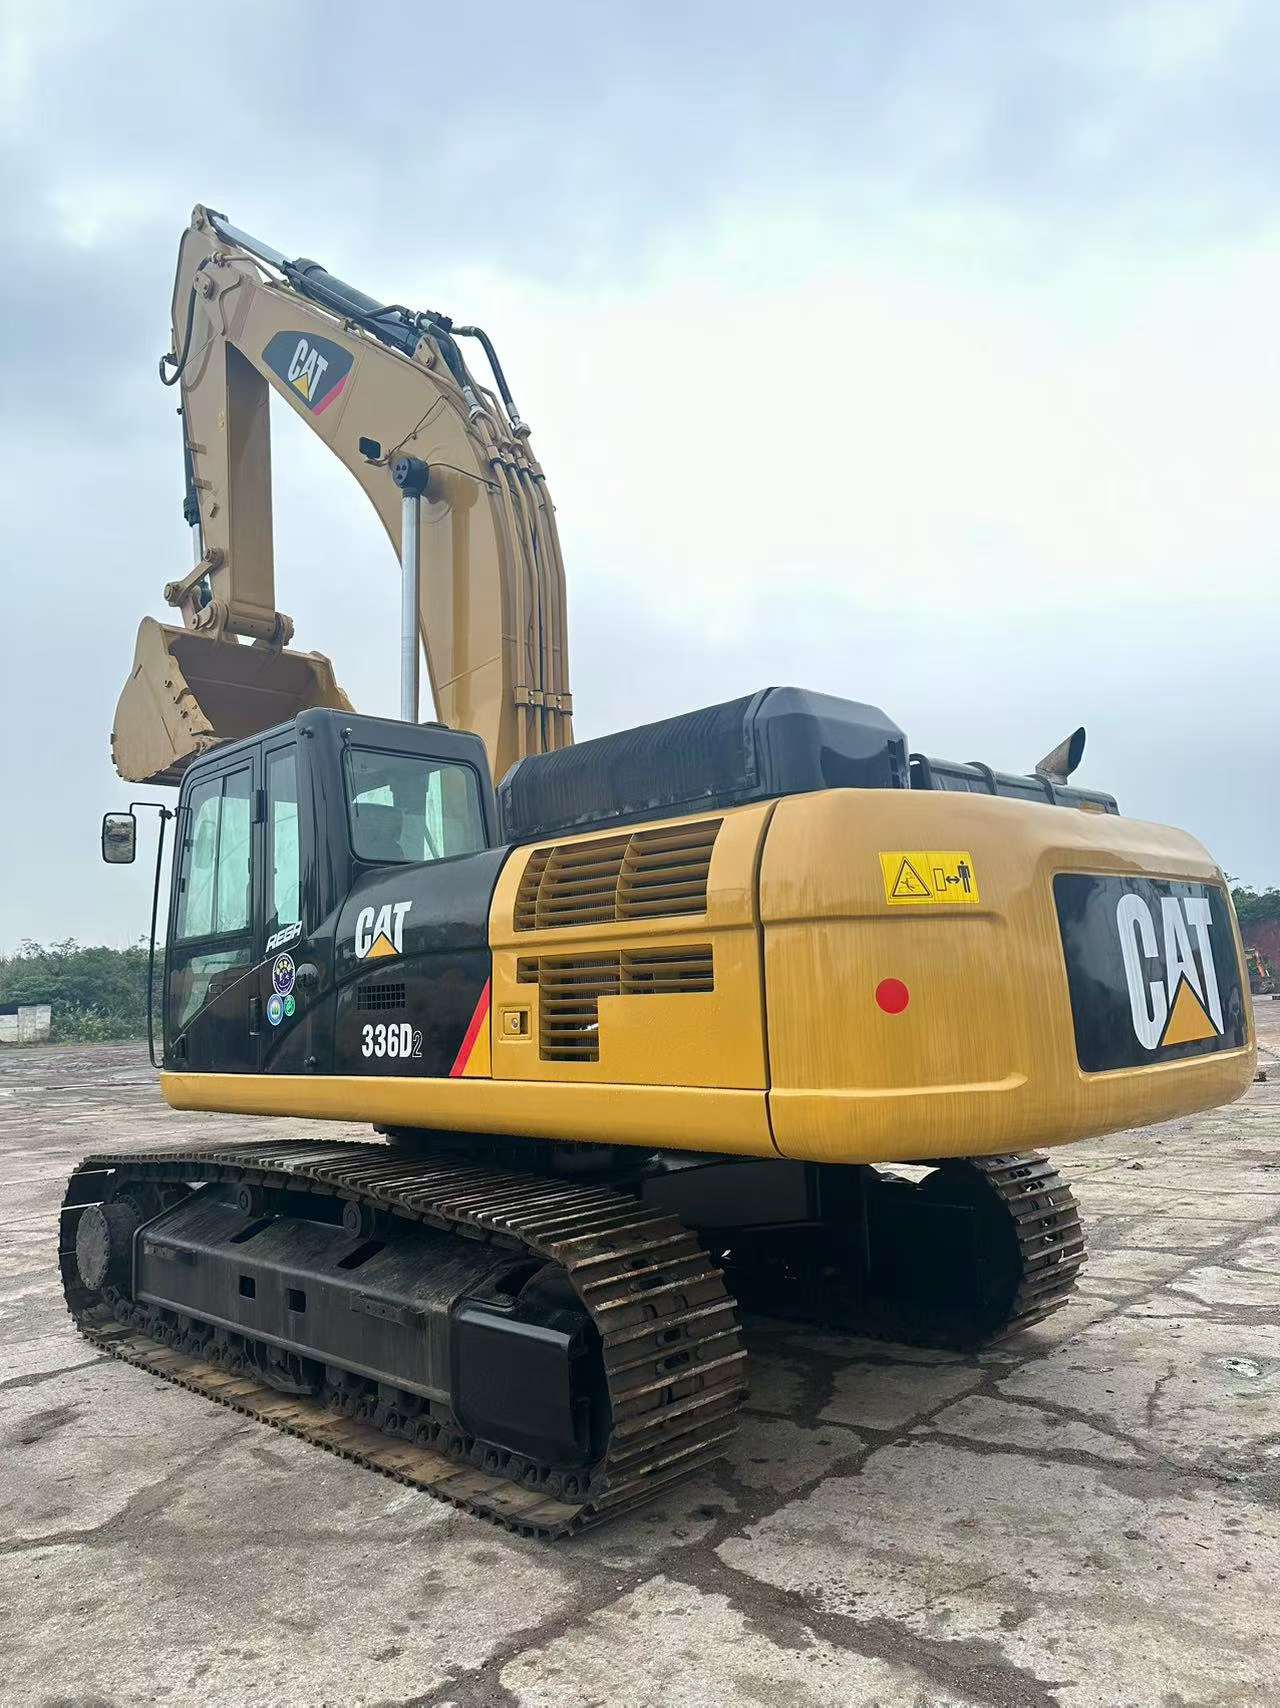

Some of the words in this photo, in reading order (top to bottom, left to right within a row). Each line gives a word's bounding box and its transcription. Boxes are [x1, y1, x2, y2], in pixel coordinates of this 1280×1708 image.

[287, 338, 329, 402] CAT
[355, 900, 413, 959] CAT
[1116, 893, 1225, 1050] CAT
